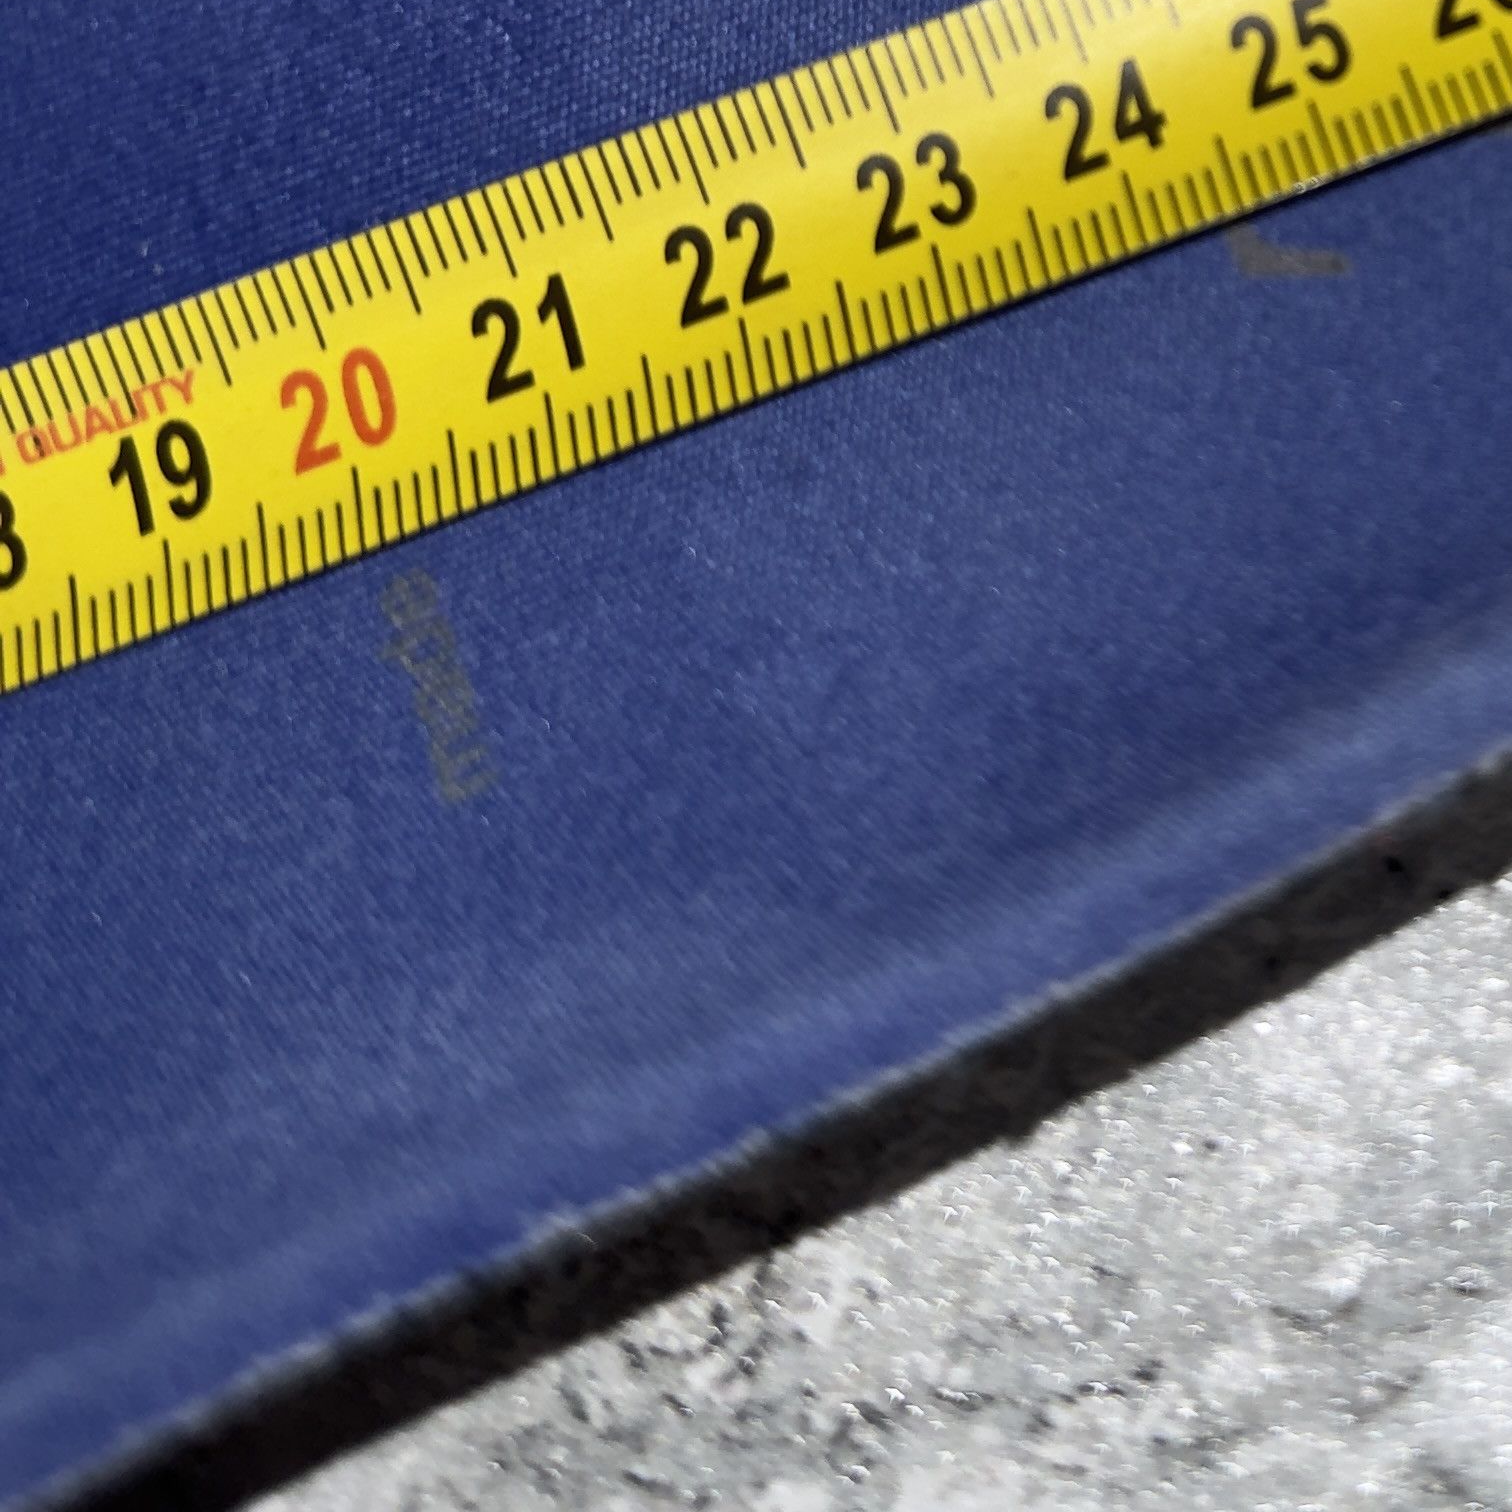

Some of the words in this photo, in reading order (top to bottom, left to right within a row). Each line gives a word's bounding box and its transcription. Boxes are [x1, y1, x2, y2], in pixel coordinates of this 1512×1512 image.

[15, 368, 195, 465] QUALITY
[108, 419, 212, 538] 19
[279, 346, 397, 475] 20
[470, 272, 586, 404] 21
[663, 203, 791, 330] 22
[855, 134, 977, 256] 23
[1043, 61, 1167, 183] 24
